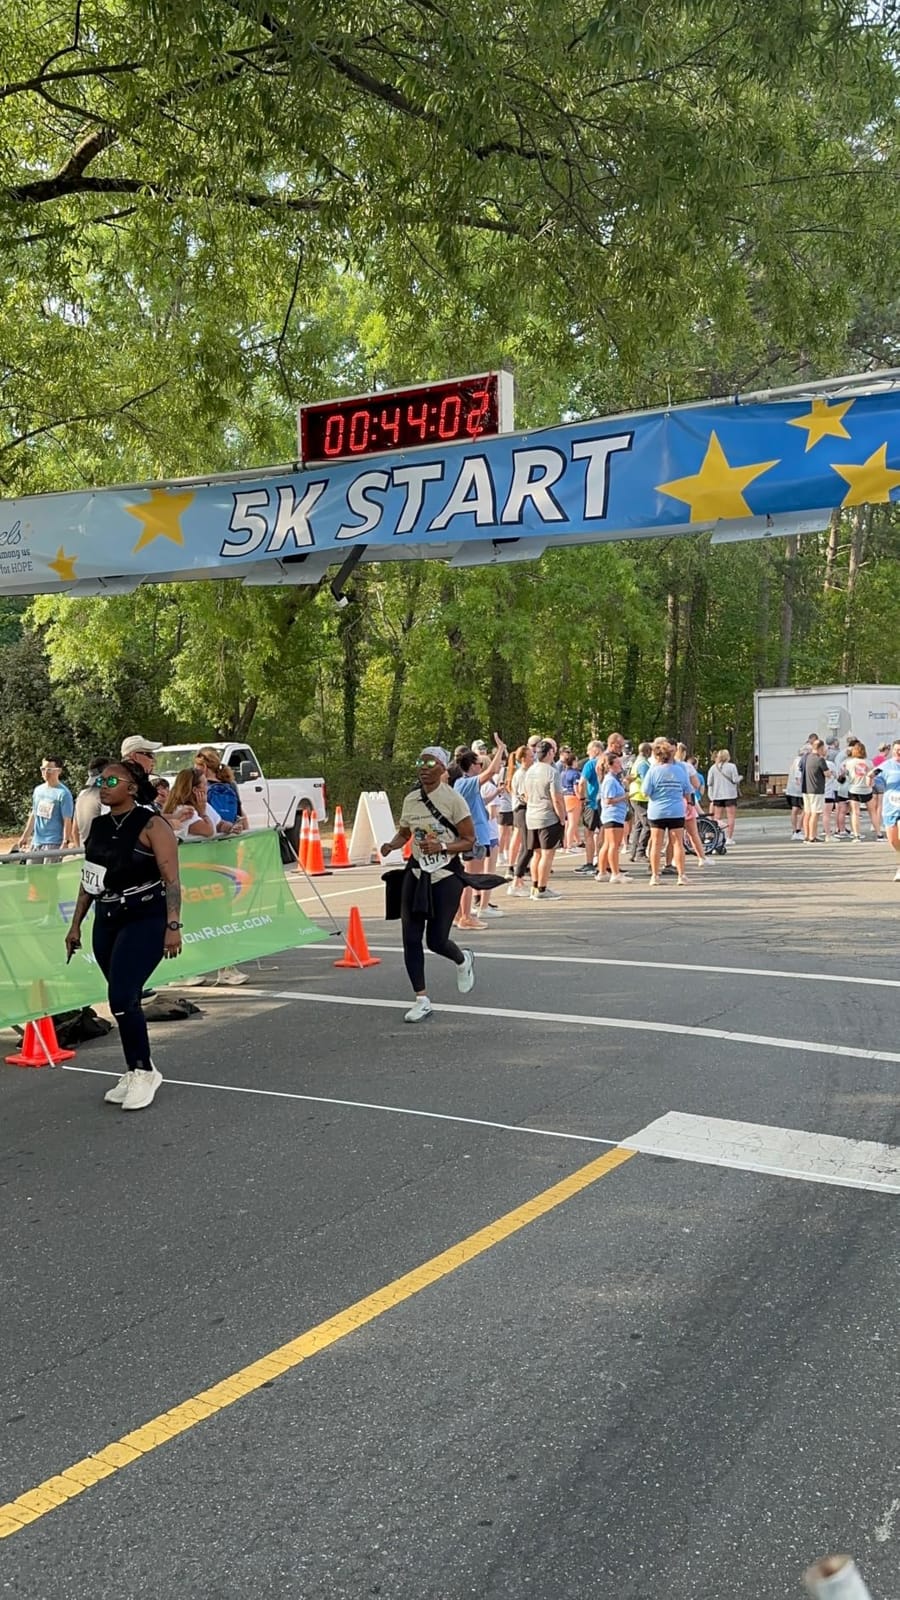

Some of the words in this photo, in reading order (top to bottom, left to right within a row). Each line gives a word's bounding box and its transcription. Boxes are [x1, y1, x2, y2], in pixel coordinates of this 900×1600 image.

[324, 391, 489, 455] 00:44:02
[220, 478, 329, 557] 5K
[334, 431, 634, 541] START
[21, 548, 31, 556] us
[11, 561, 33, 573] HOPE
[81, 868, 99, 887] 1971
